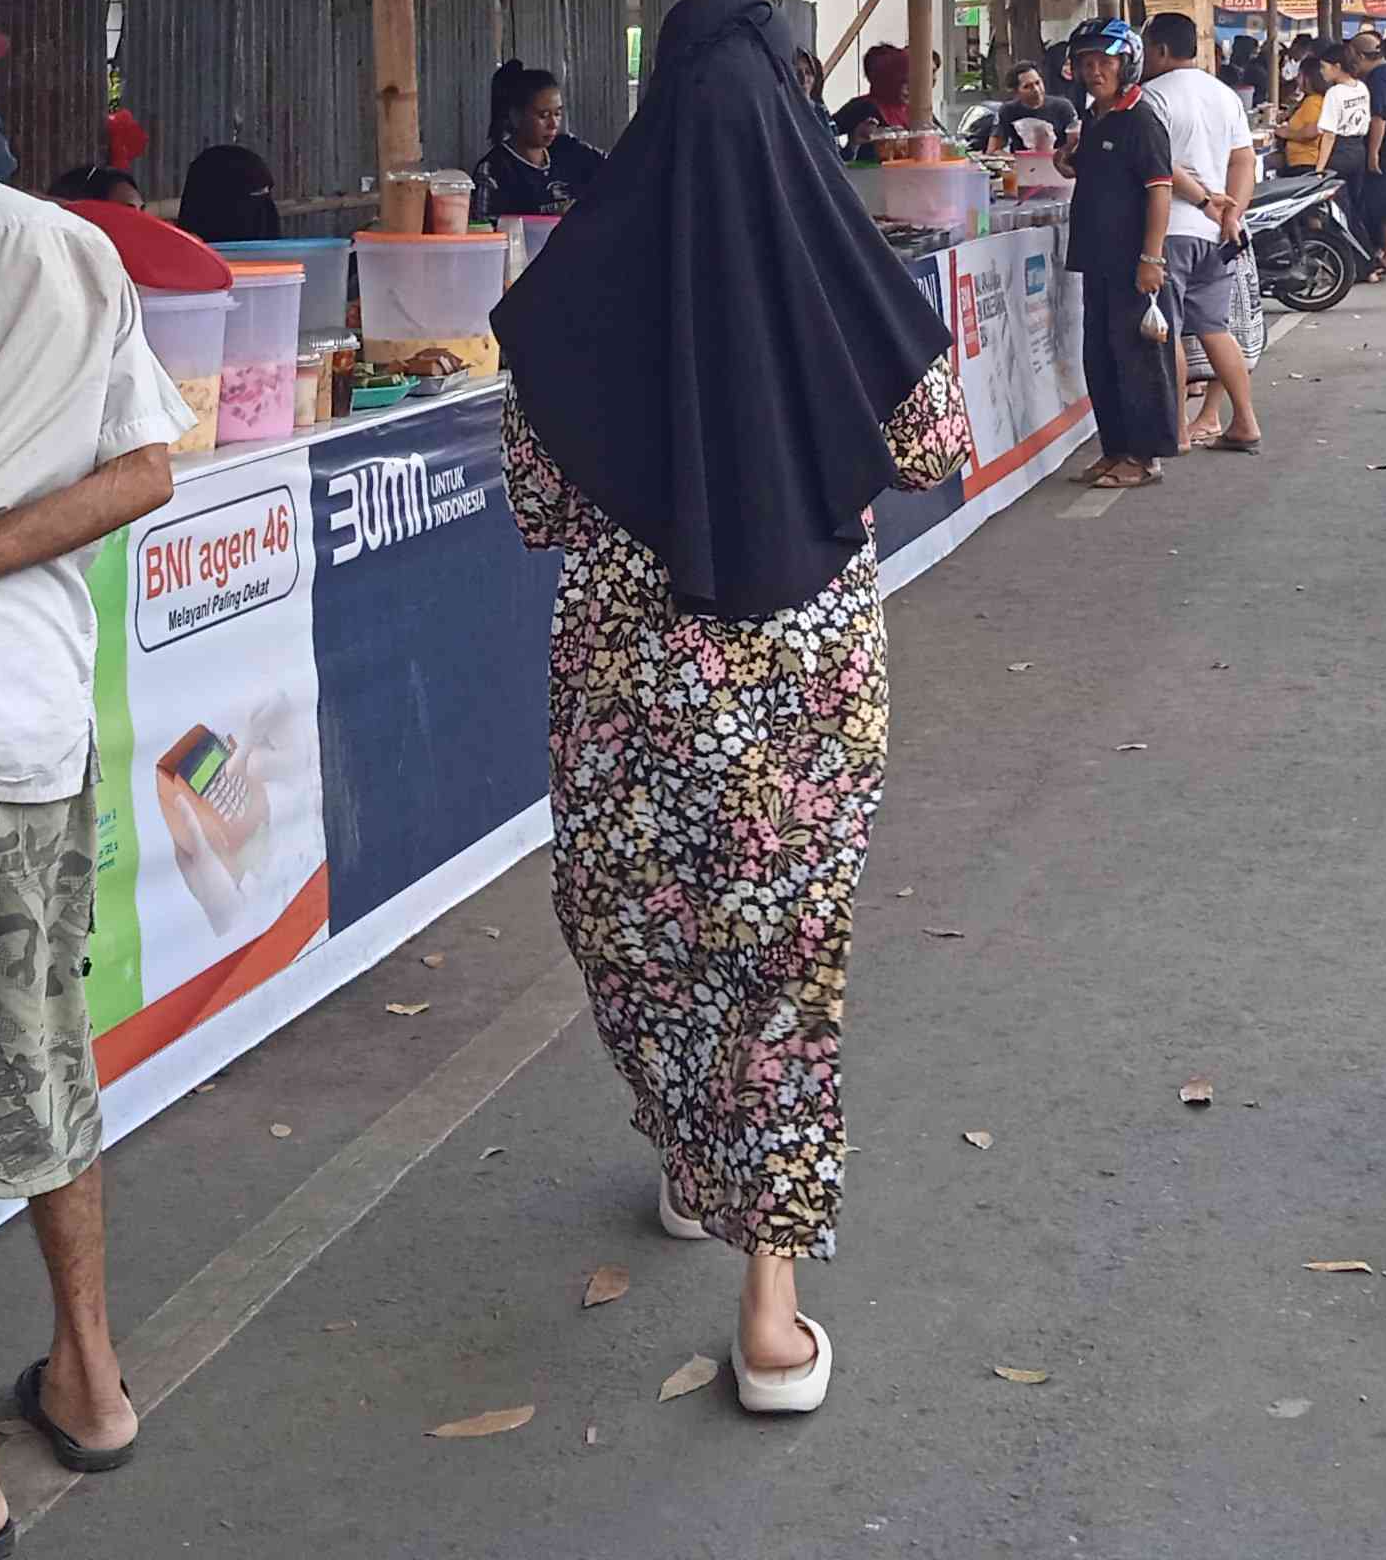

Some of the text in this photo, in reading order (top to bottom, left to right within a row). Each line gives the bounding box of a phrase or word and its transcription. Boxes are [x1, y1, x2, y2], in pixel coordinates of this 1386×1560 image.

[429, 464, 466, 498] UNTUK
[432, 487, 487, 528] INDONESIA
[144, 503, 291, 601] BNI agen 46
[167, 577, 271, 632] Melayani Paling Dekat
